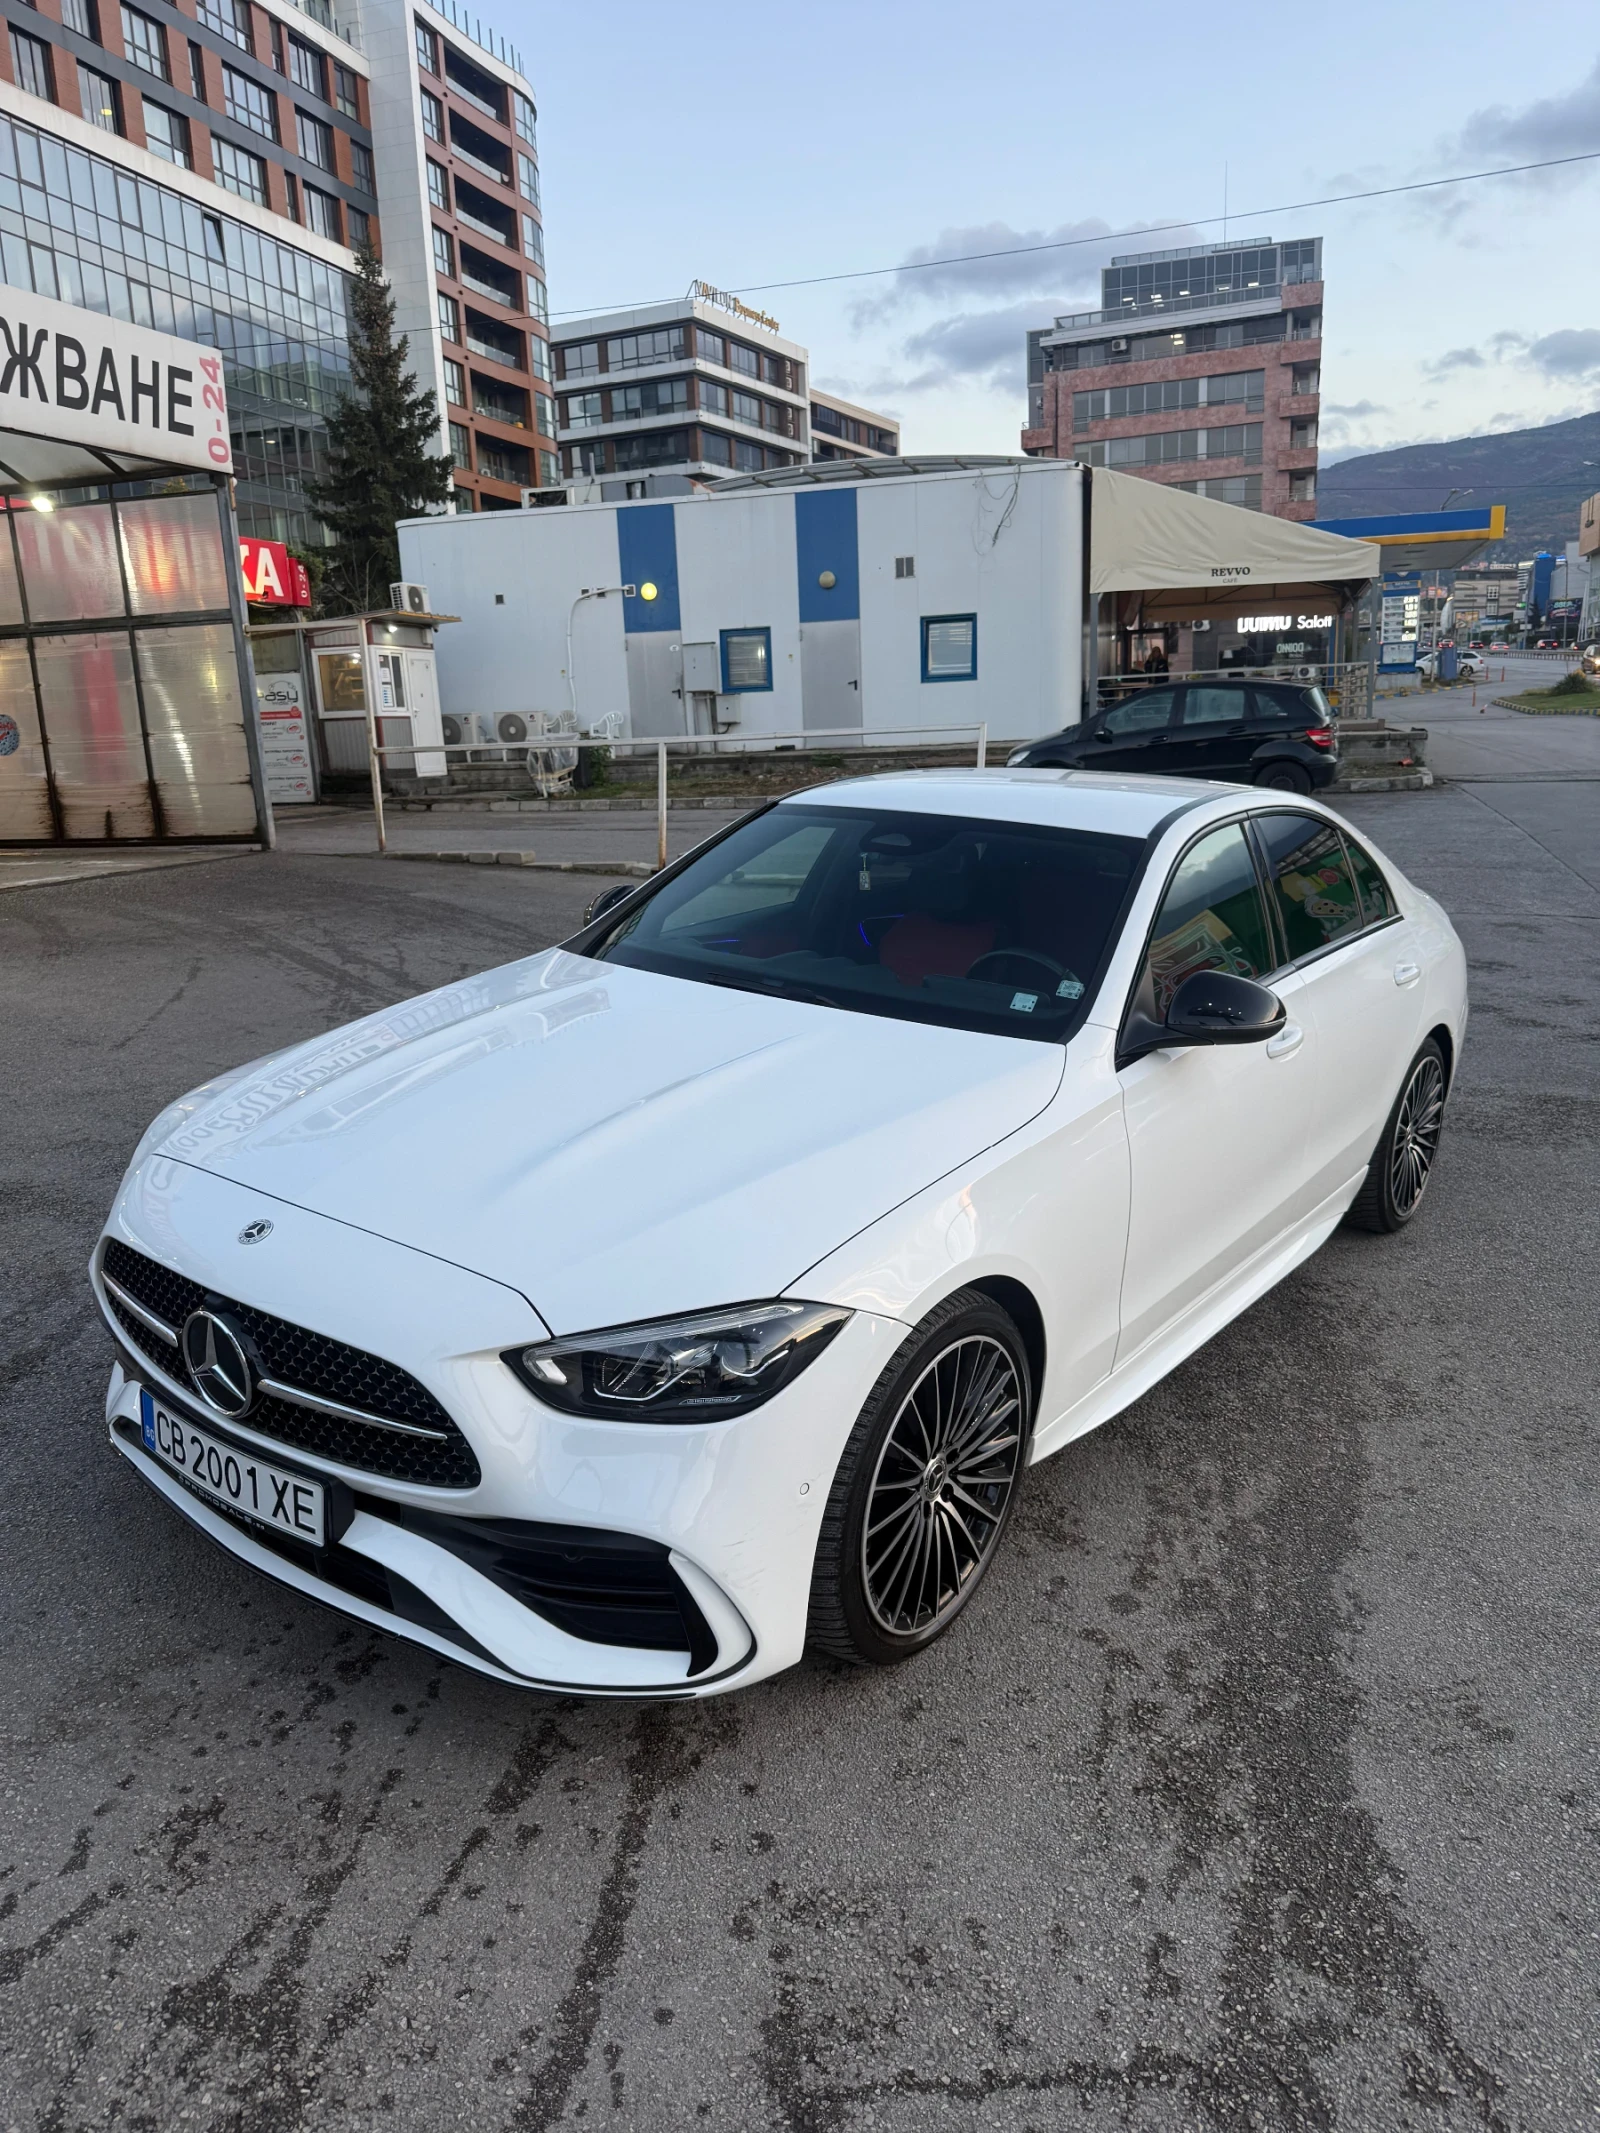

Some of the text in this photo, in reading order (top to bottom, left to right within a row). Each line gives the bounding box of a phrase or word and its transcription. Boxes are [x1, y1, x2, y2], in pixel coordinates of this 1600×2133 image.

[0, 316, 194, 437] ЖВАНЕ
[1211, 567, 1250, 577] REVVO
[145, 1424, 155, 1442] BG
